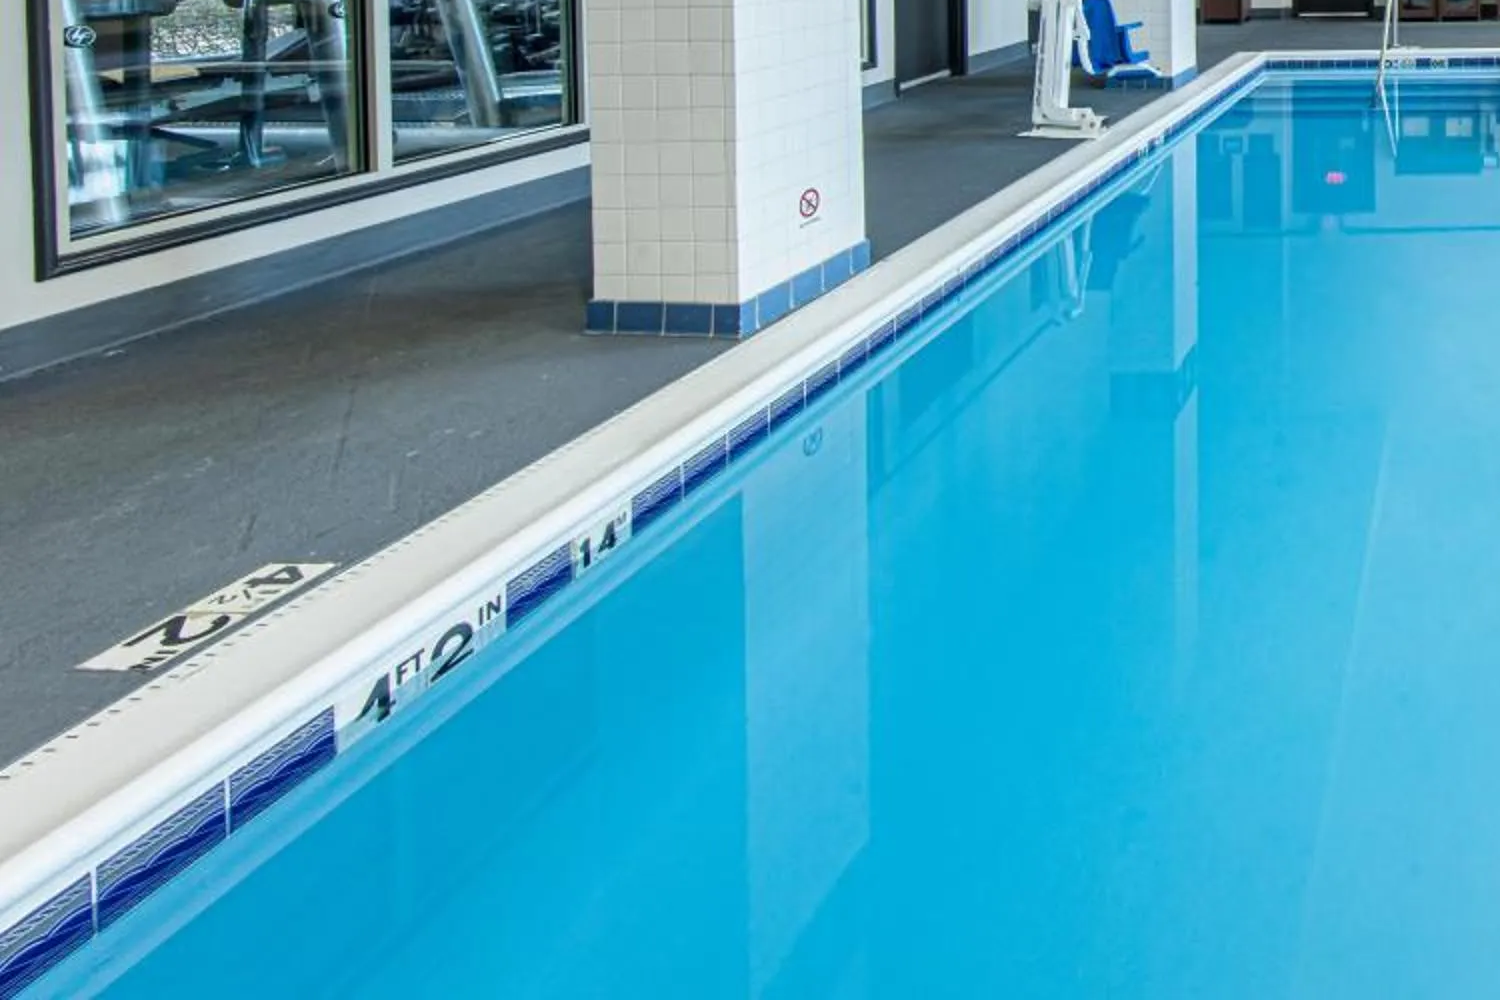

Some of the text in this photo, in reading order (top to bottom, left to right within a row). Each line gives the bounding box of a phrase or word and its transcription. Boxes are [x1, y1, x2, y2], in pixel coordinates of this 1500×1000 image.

[121, 614, 231, 646] 2
[354, 594, 502, 723] 4 FT 2 IN
